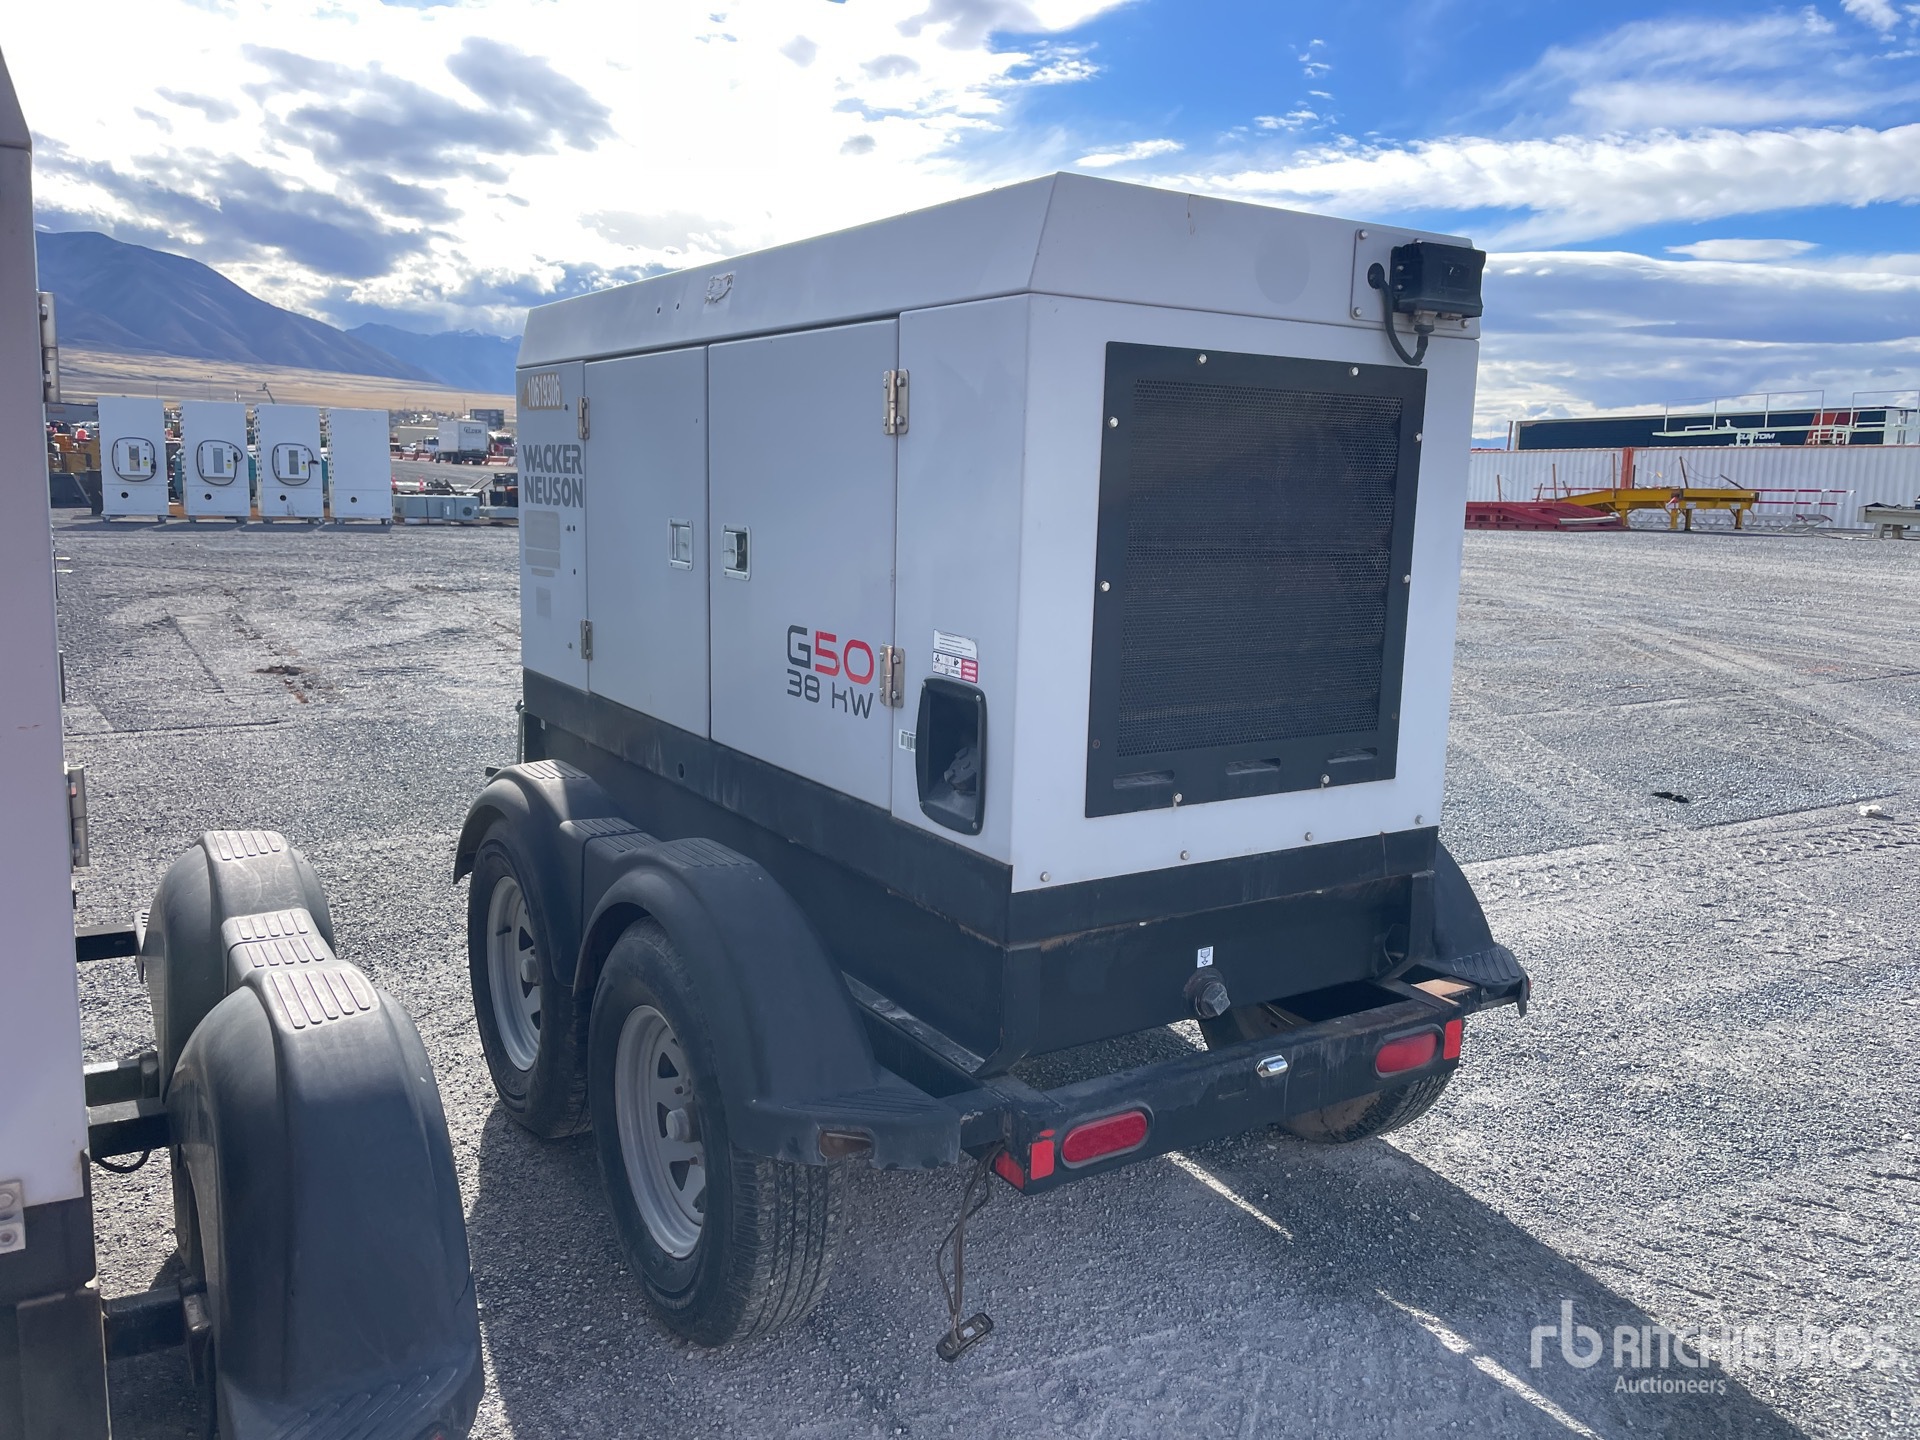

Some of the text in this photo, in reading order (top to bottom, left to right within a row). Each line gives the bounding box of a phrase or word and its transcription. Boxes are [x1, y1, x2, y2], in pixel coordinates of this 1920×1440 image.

[522, 444, 583, 475] WACKER
[524, 476, 583, 508] NEUSON
[787, 624, 875, 685] G50
[787, 668, 820, 703] 38
